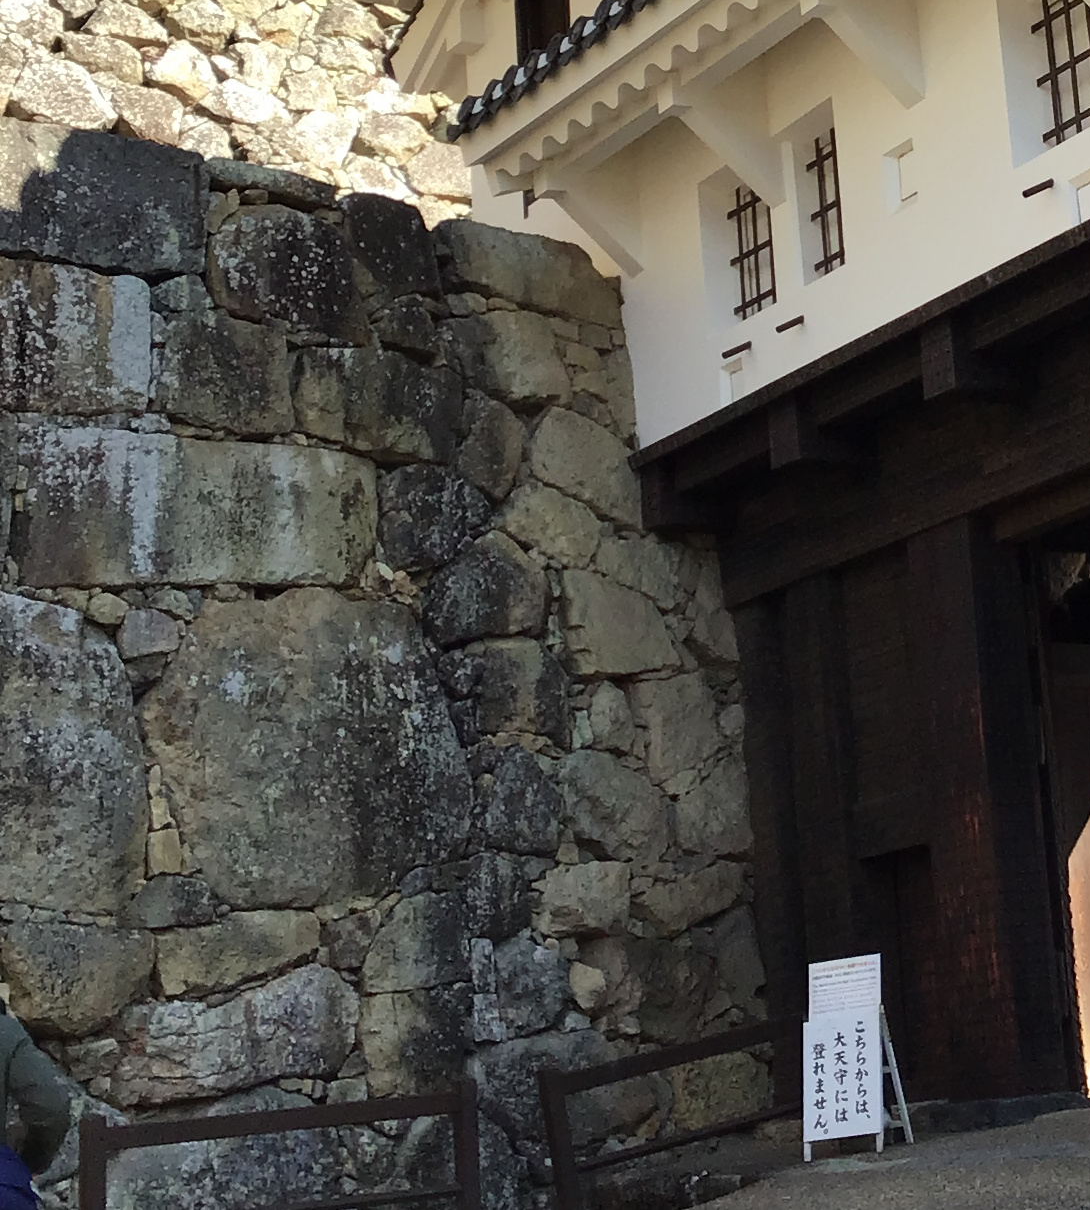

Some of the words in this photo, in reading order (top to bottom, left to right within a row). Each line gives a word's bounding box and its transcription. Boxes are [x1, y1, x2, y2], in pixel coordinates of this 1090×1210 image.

[812, 1042, 829, 1135] 登れません。
[833, 1031, 848, 1123] 大天守には
[855, 1020, 871, 1119] こちらからは、
